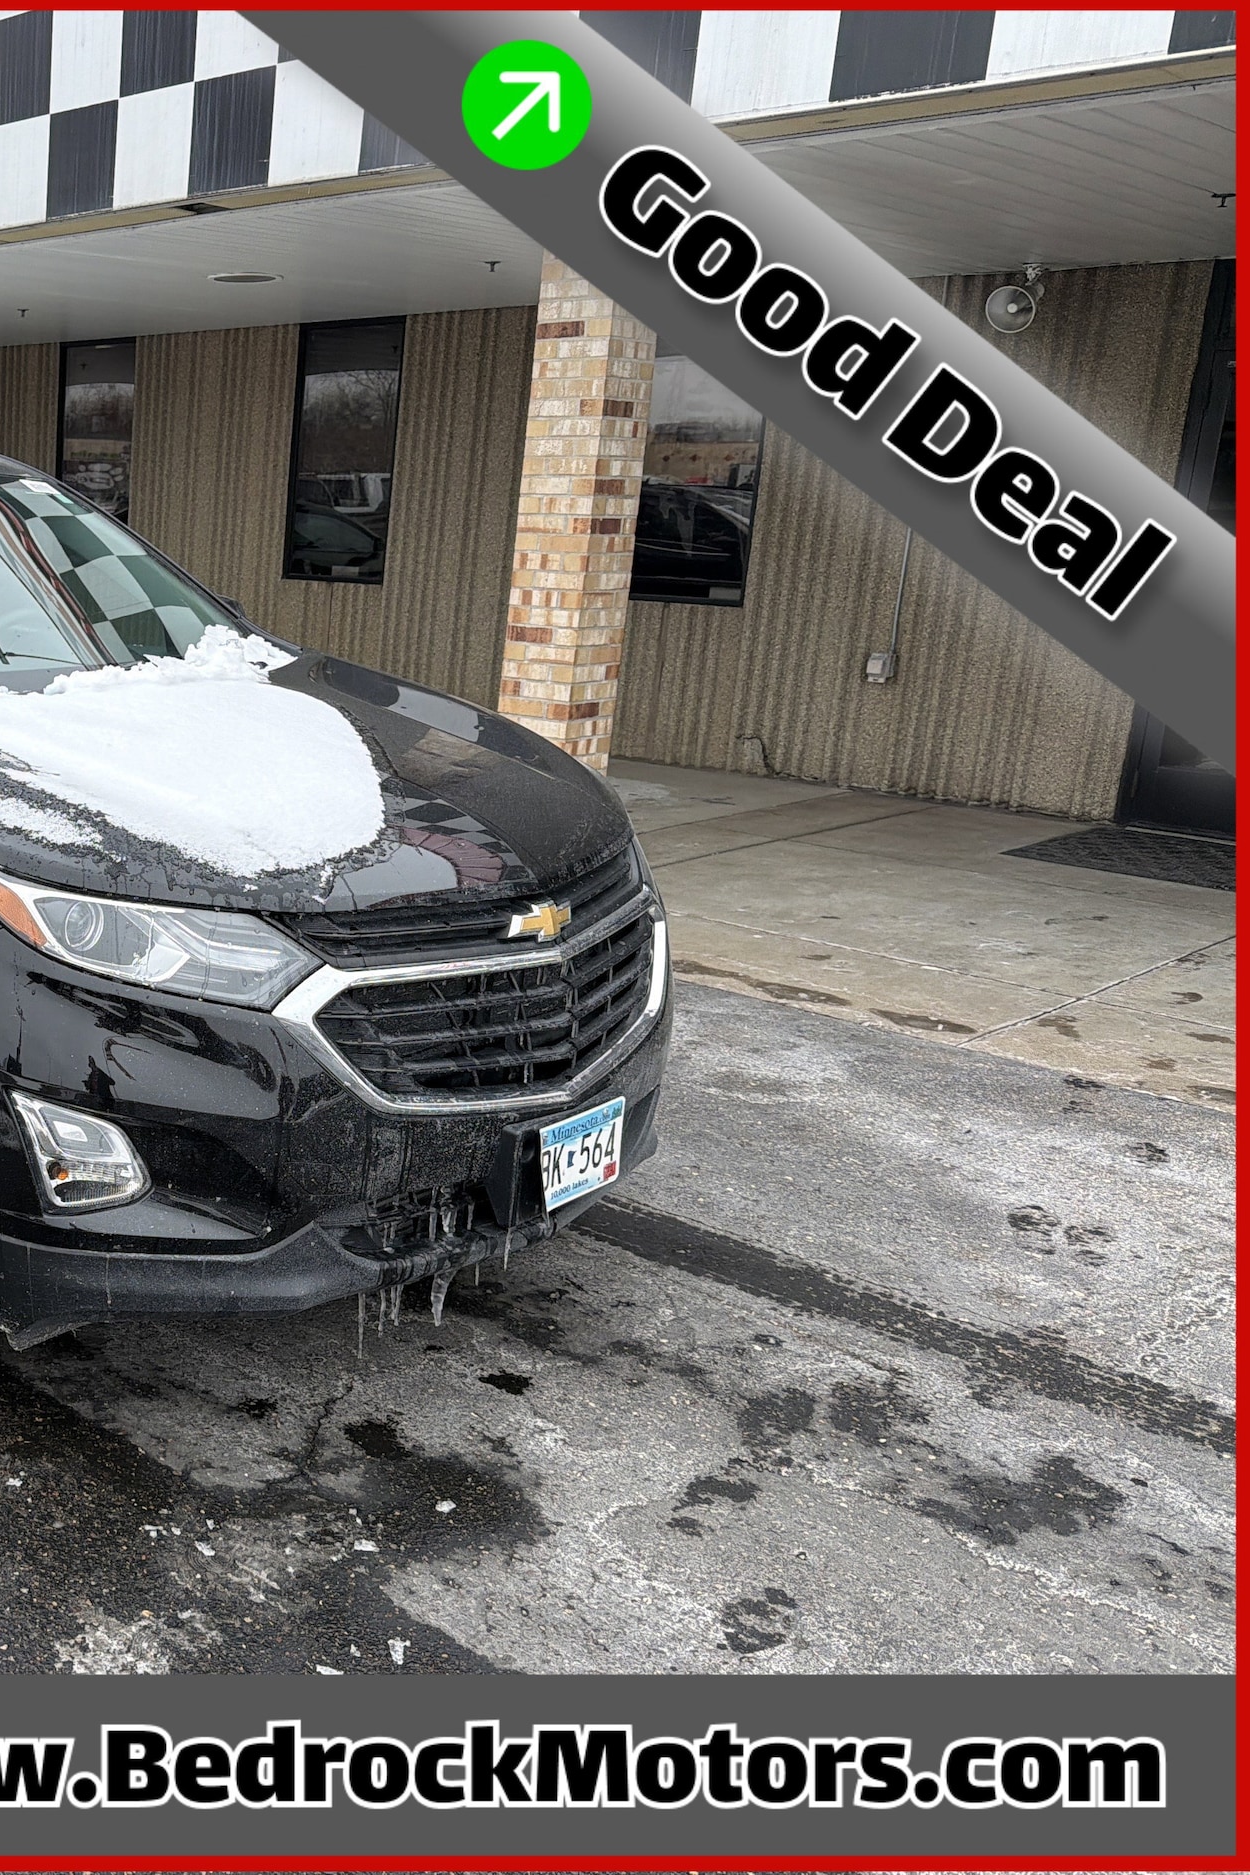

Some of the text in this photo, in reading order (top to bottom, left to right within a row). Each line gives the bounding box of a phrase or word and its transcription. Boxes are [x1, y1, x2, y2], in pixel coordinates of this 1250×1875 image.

[579, 1121, 617, 1175] 564
[550, 1178, 590, 1201] 10,000 lakes
